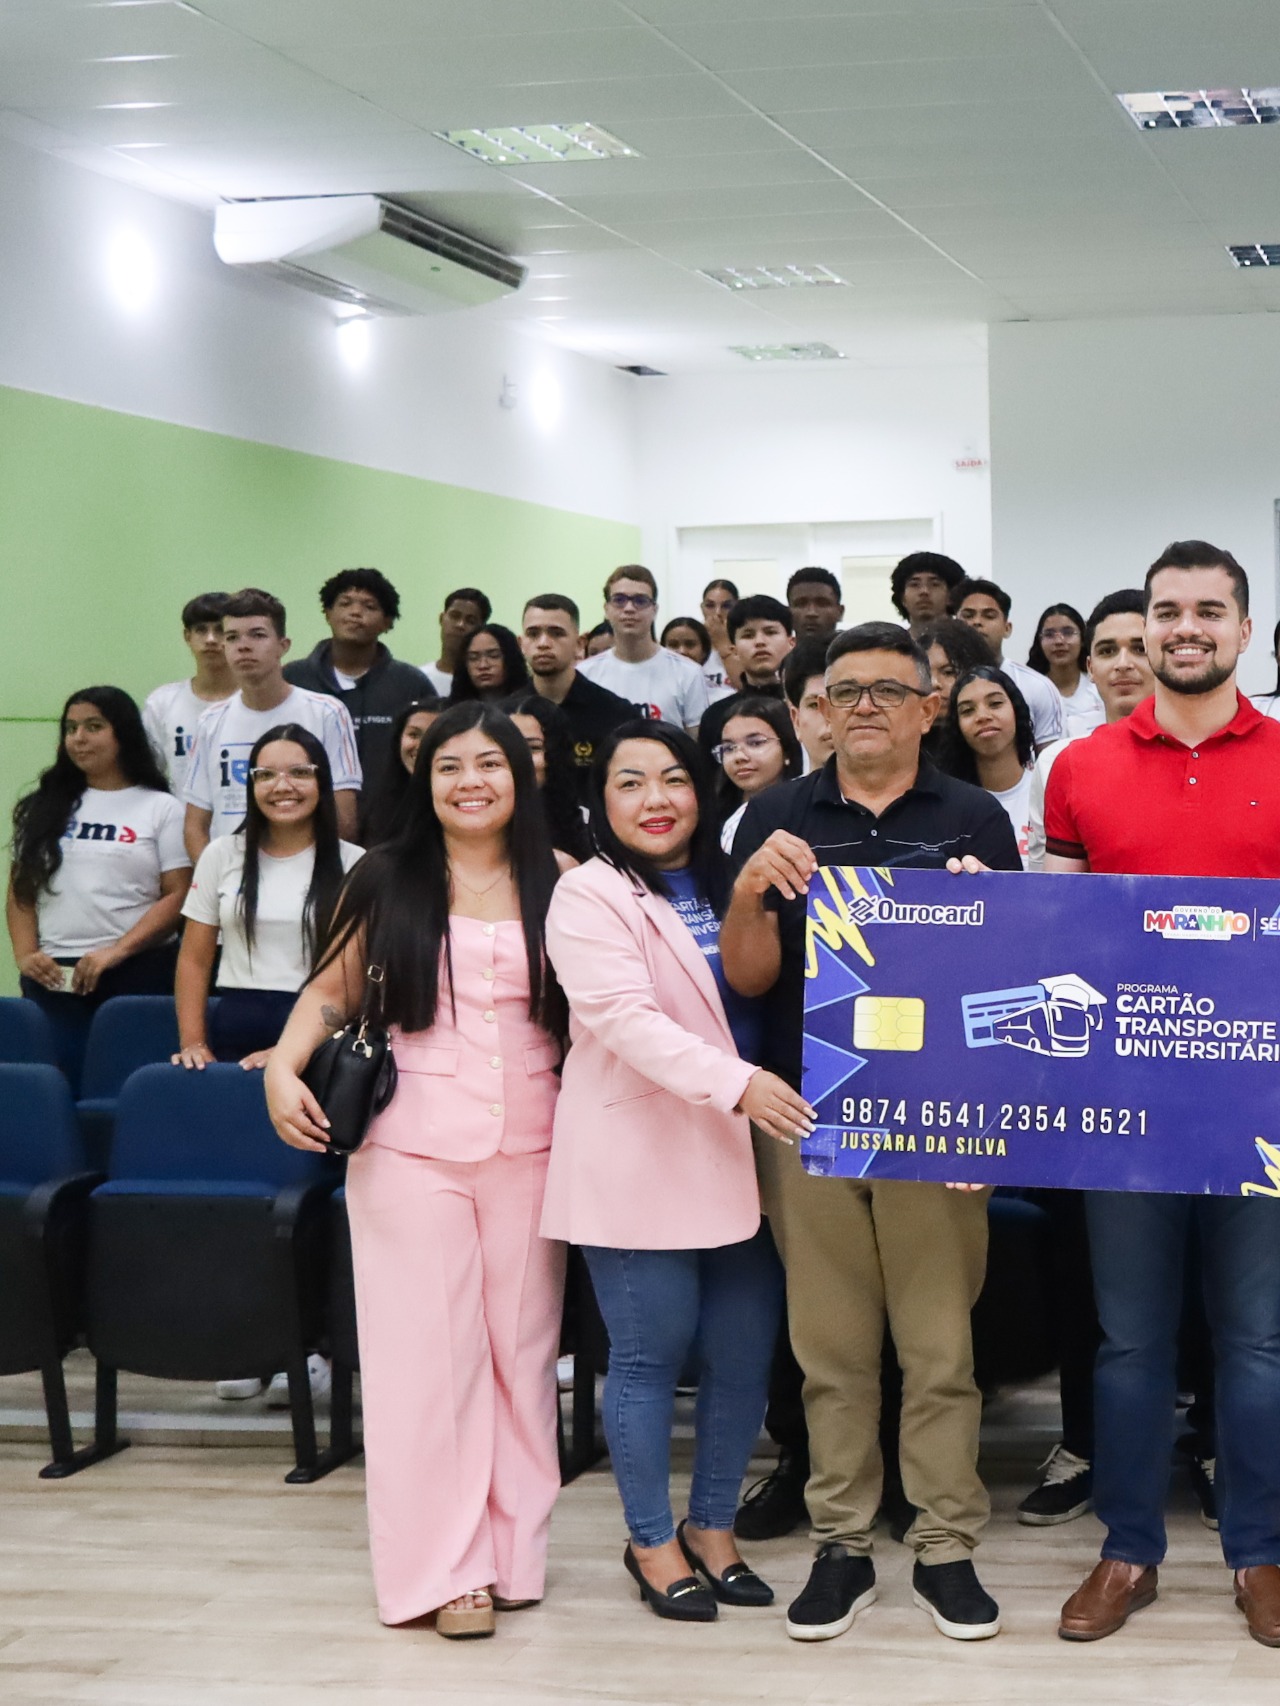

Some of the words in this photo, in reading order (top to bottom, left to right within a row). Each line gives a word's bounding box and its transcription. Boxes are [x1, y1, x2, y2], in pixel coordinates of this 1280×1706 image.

[877, 899, 984, 925] Ourocard
[1116, 983, 1179, 995] PROGRAMA
[1116, 993, 1215, 1016] CARTÃO
[1116, 1017, 1277, 1040] TRANSPORTE
[841, 1097, 907, 1126] 9874
[920, 1100, 986, 1129] 6541
[1000, 1103, 1067, 1132] 2354
[1081, 1107, 1148, 1136] 8521
[841, 1130, 917, 1154] JUSSARA
[925, 1134, 948, 1155] DA
[955, 1136, 1008, 1158] SILVA
